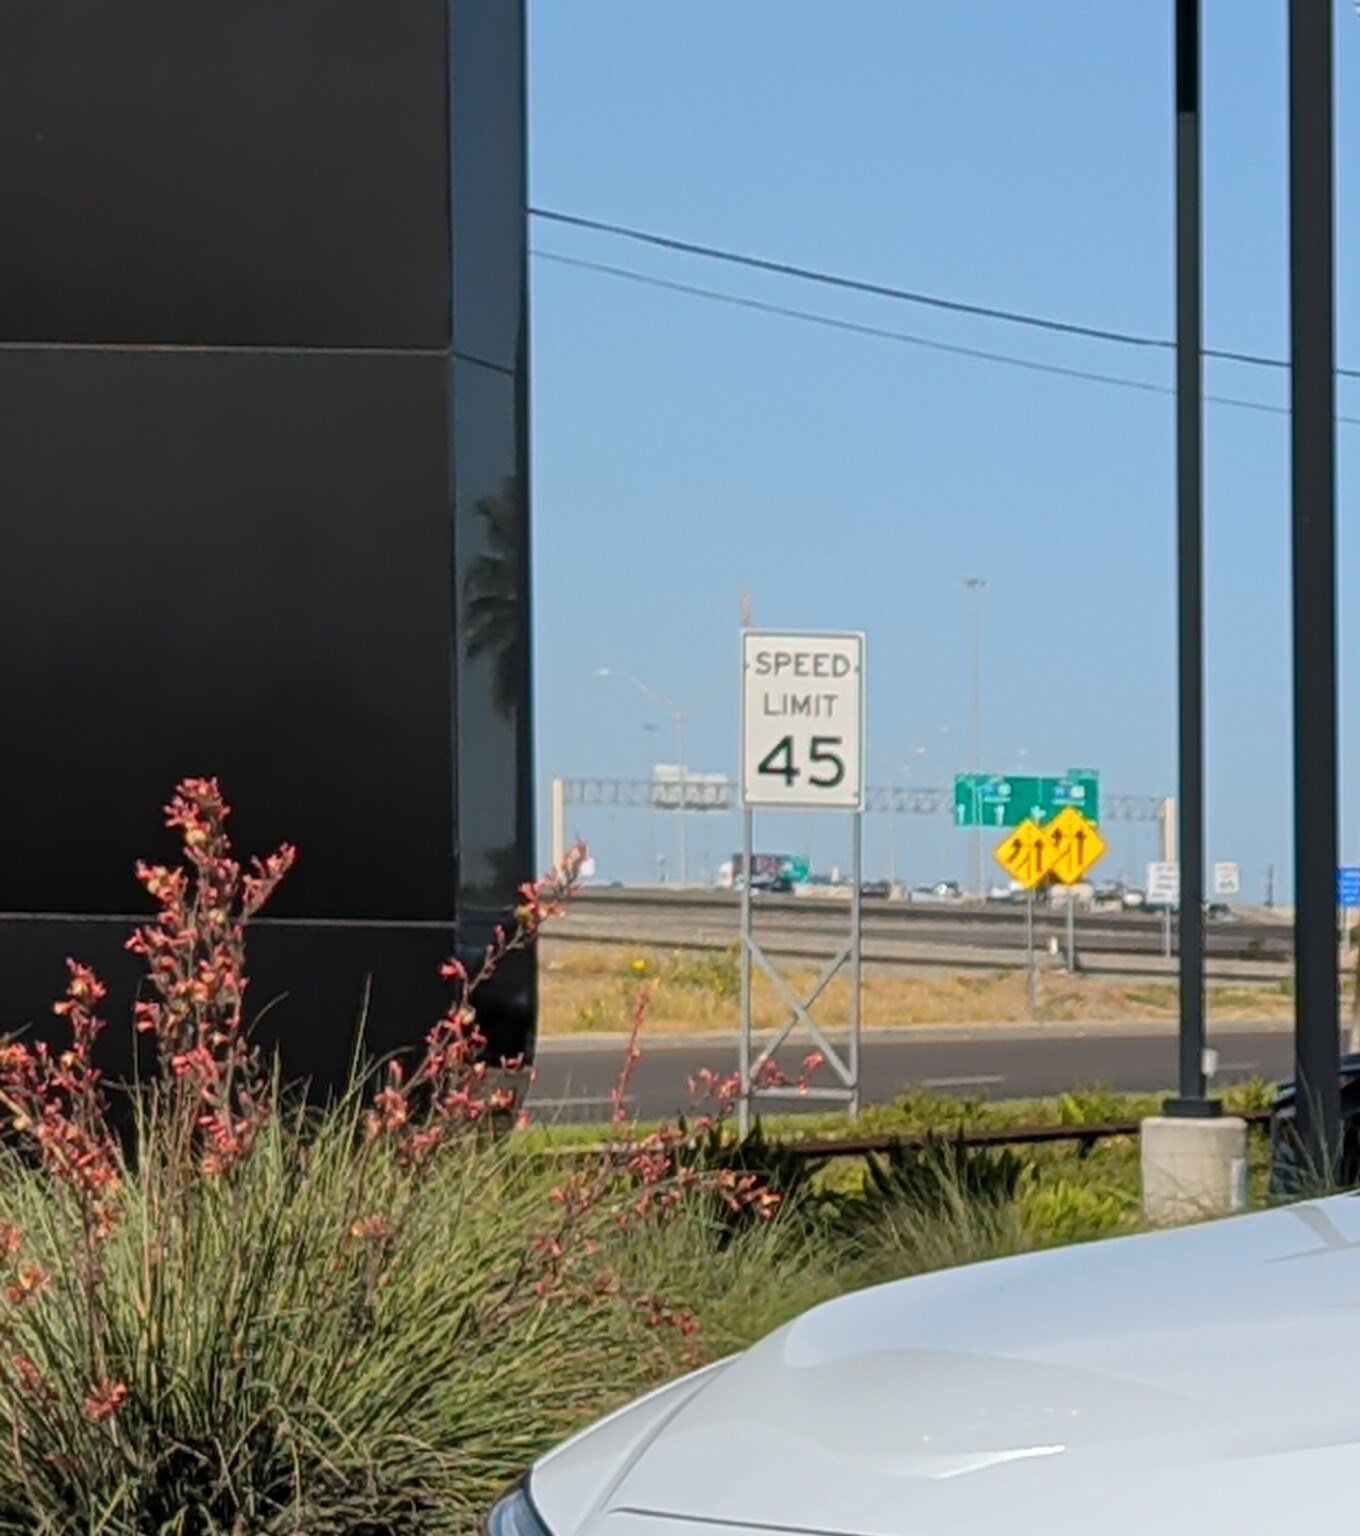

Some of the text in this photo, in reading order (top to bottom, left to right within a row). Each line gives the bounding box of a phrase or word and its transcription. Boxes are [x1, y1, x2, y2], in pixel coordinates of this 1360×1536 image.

[755, 652, 850, 678] SPEED
[764, 693, 837, 718] LIMIT
[758, 735, 845, 788] 45
